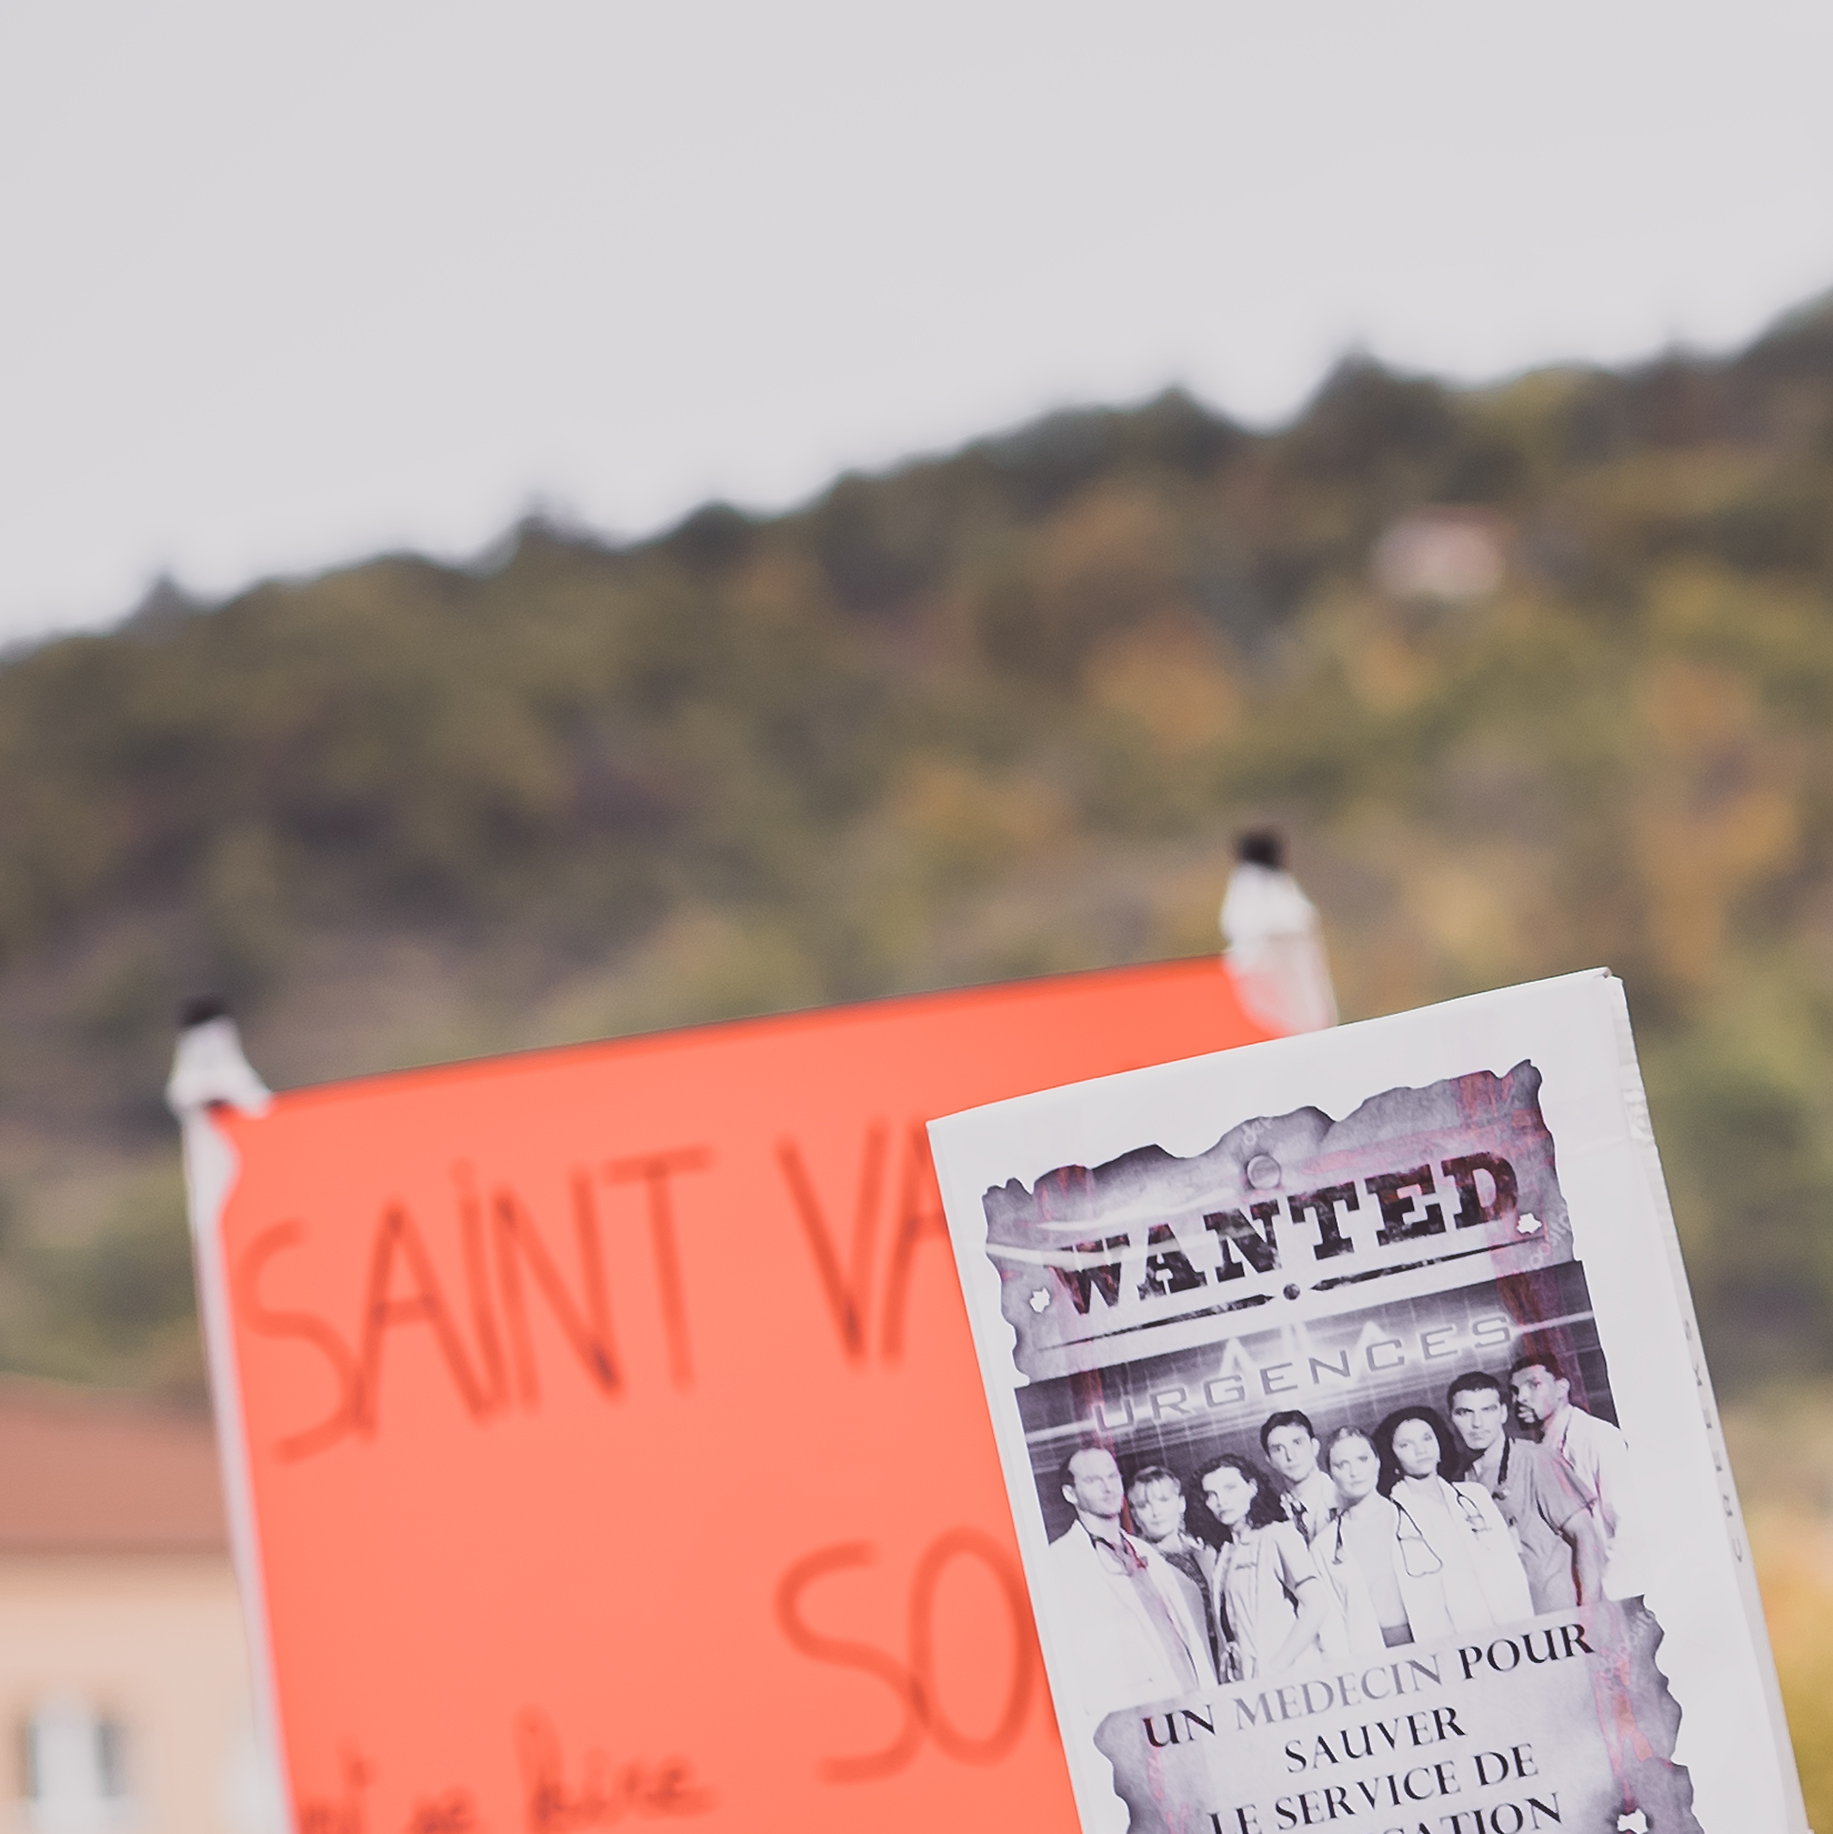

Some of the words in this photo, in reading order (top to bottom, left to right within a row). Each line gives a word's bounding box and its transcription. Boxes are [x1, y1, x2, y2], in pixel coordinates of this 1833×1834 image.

[1048, 1152, 1518, 1316] WANTED
[1094, 1315, 1513, 1432] URGENCES
[771, 1525, 1060, 1785] SO
[1142, 1704, 1216, 1748] UN
[1231, 1653, 1442, 1731] MEDECIN
[1458, 1622, 1595, 1680] POUR
[1275, 1760, 1461, 1831] SERVICE
[1474, 1743, 1539, 1788] DE
[1284, 1706, 1466, 1774] SAUVER
